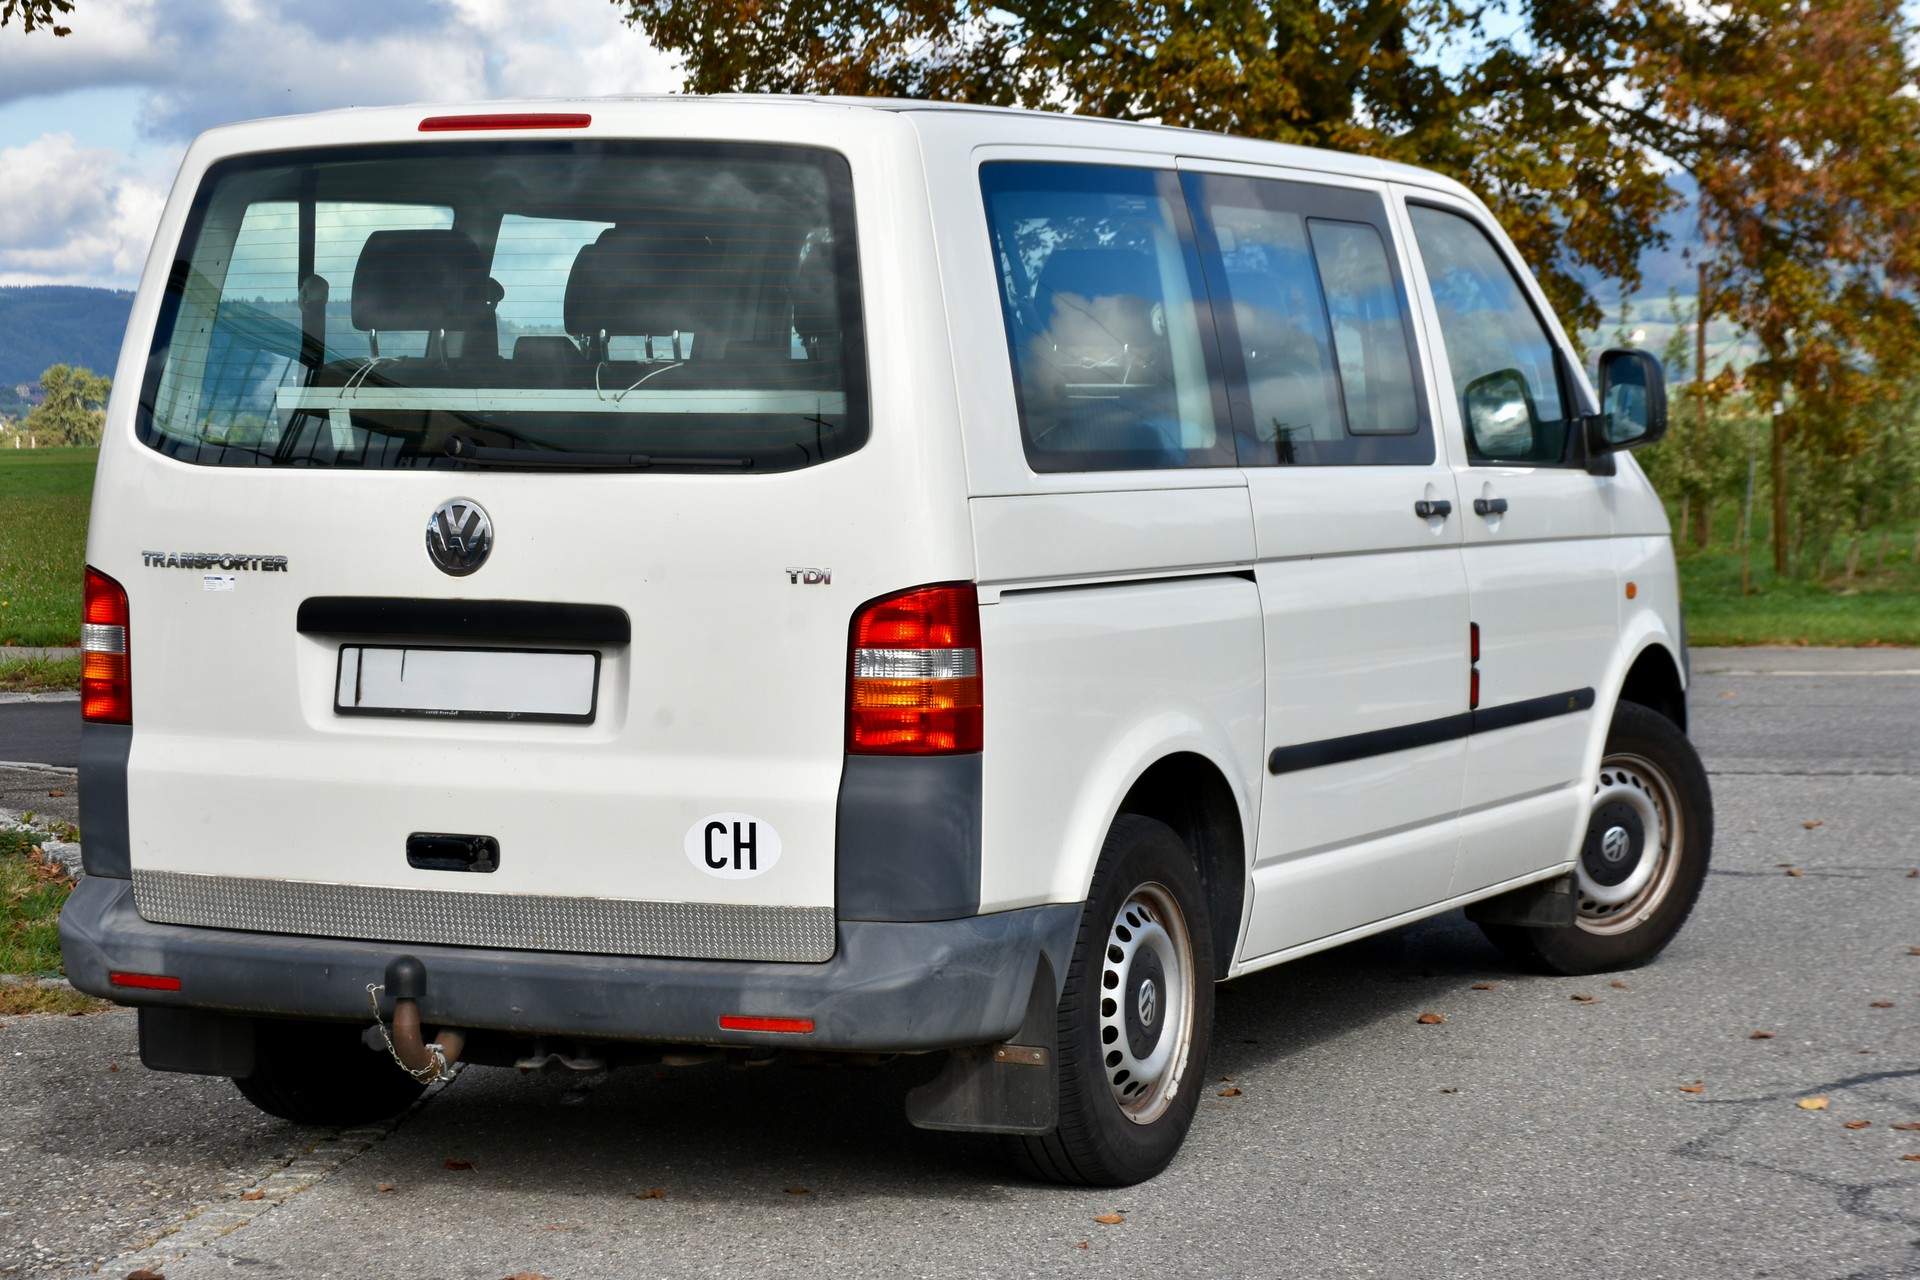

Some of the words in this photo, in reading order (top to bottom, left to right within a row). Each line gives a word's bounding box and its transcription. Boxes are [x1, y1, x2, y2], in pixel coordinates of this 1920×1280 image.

[142, 550, 288, 572] TRANSPORTER
[786, 567, 831, 585] TDI
[704, 821, 757, 870] CH
